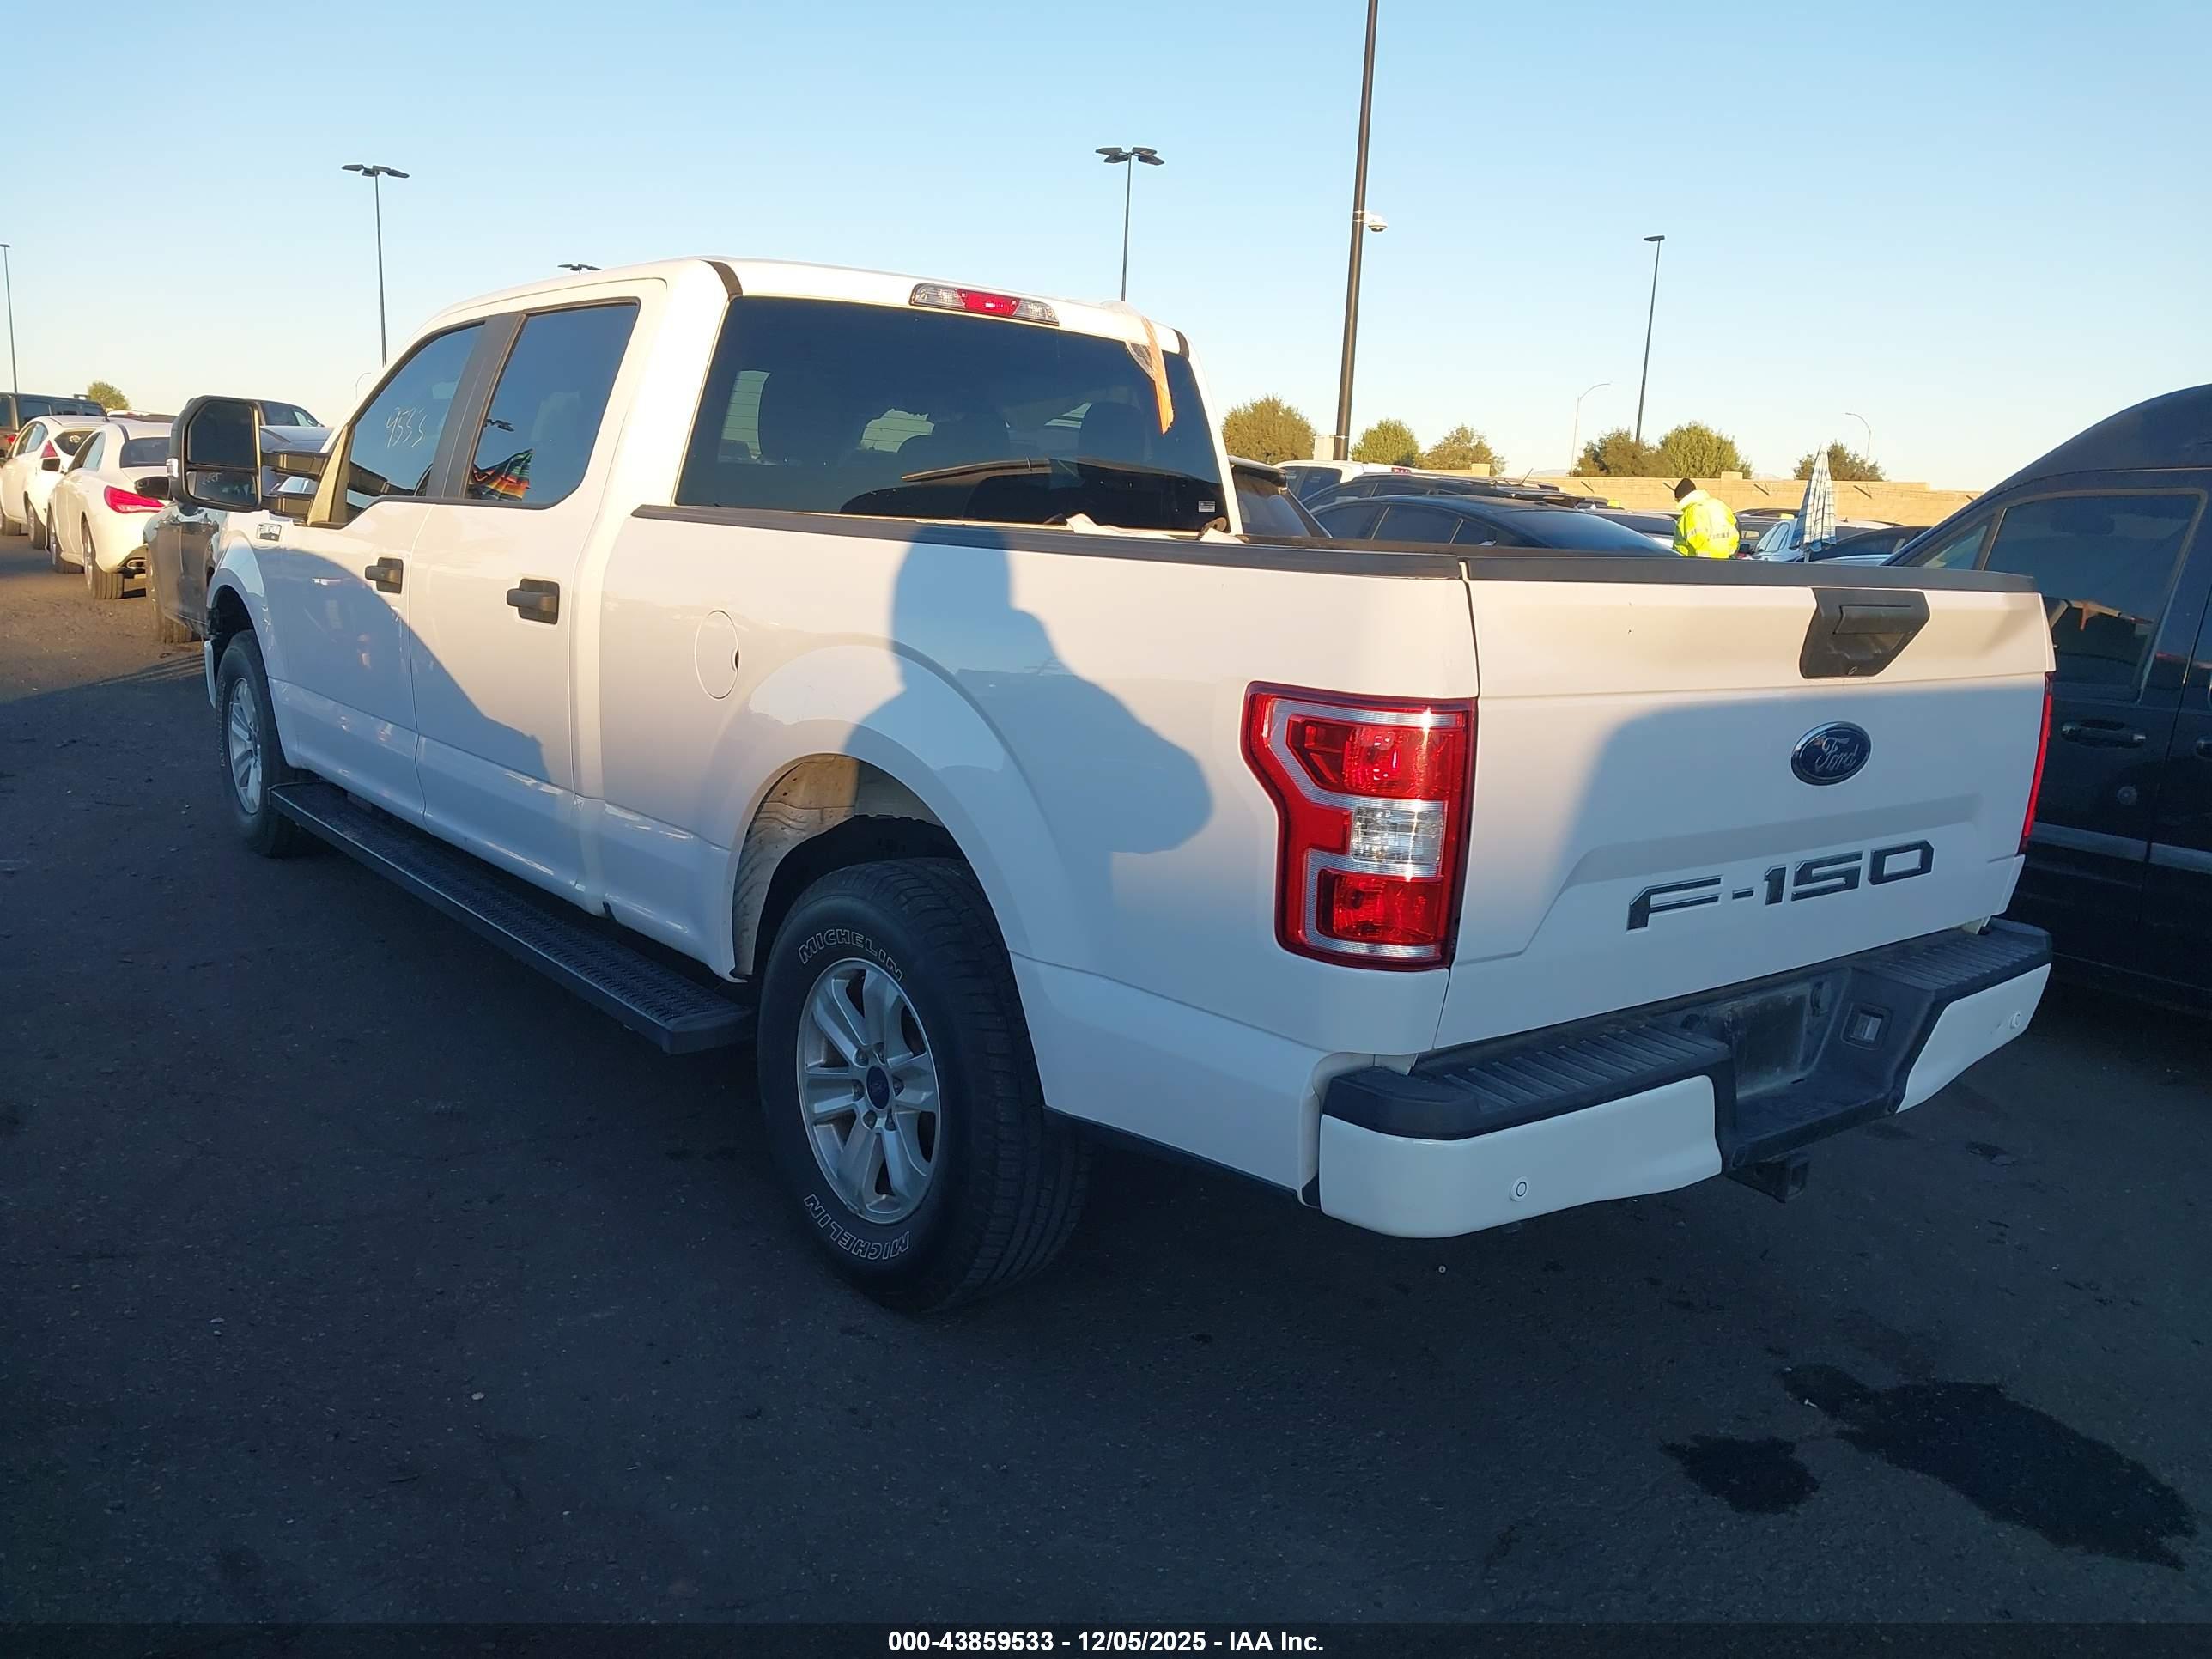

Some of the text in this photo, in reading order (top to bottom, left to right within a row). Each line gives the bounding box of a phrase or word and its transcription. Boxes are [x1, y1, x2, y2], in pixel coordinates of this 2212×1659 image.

[1814, 737, 1860, 772] Ford
[1626, 838, 1935, 932] F-150
[798, 928, 904, 981] MICHELIN
[803, 1194, 910, 1260] MICHELIN
